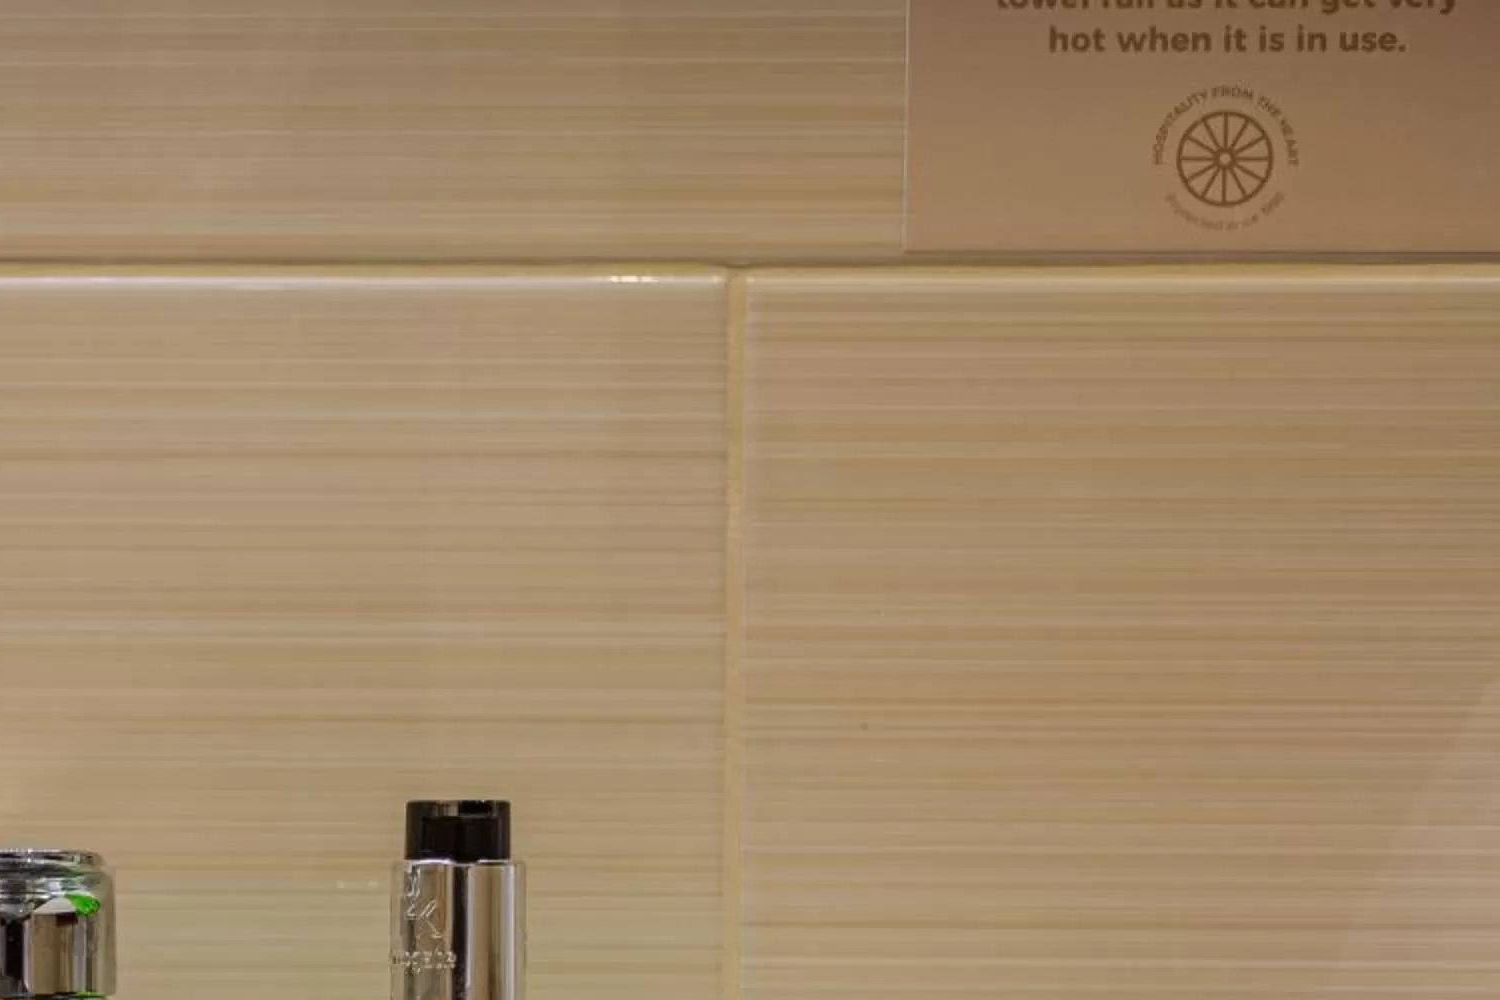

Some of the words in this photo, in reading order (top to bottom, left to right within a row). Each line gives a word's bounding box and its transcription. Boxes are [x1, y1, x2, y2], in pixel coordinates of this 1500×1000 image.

[1049, 24, 1106, 53] hot
[1116, 24, 1213, 53] when
[1223, 24, 1248, 53] it
[1259, 24, 1285, 53] is
[1296, 24, 1328, 53] in
[1338, 31, 1407, 53] use.
